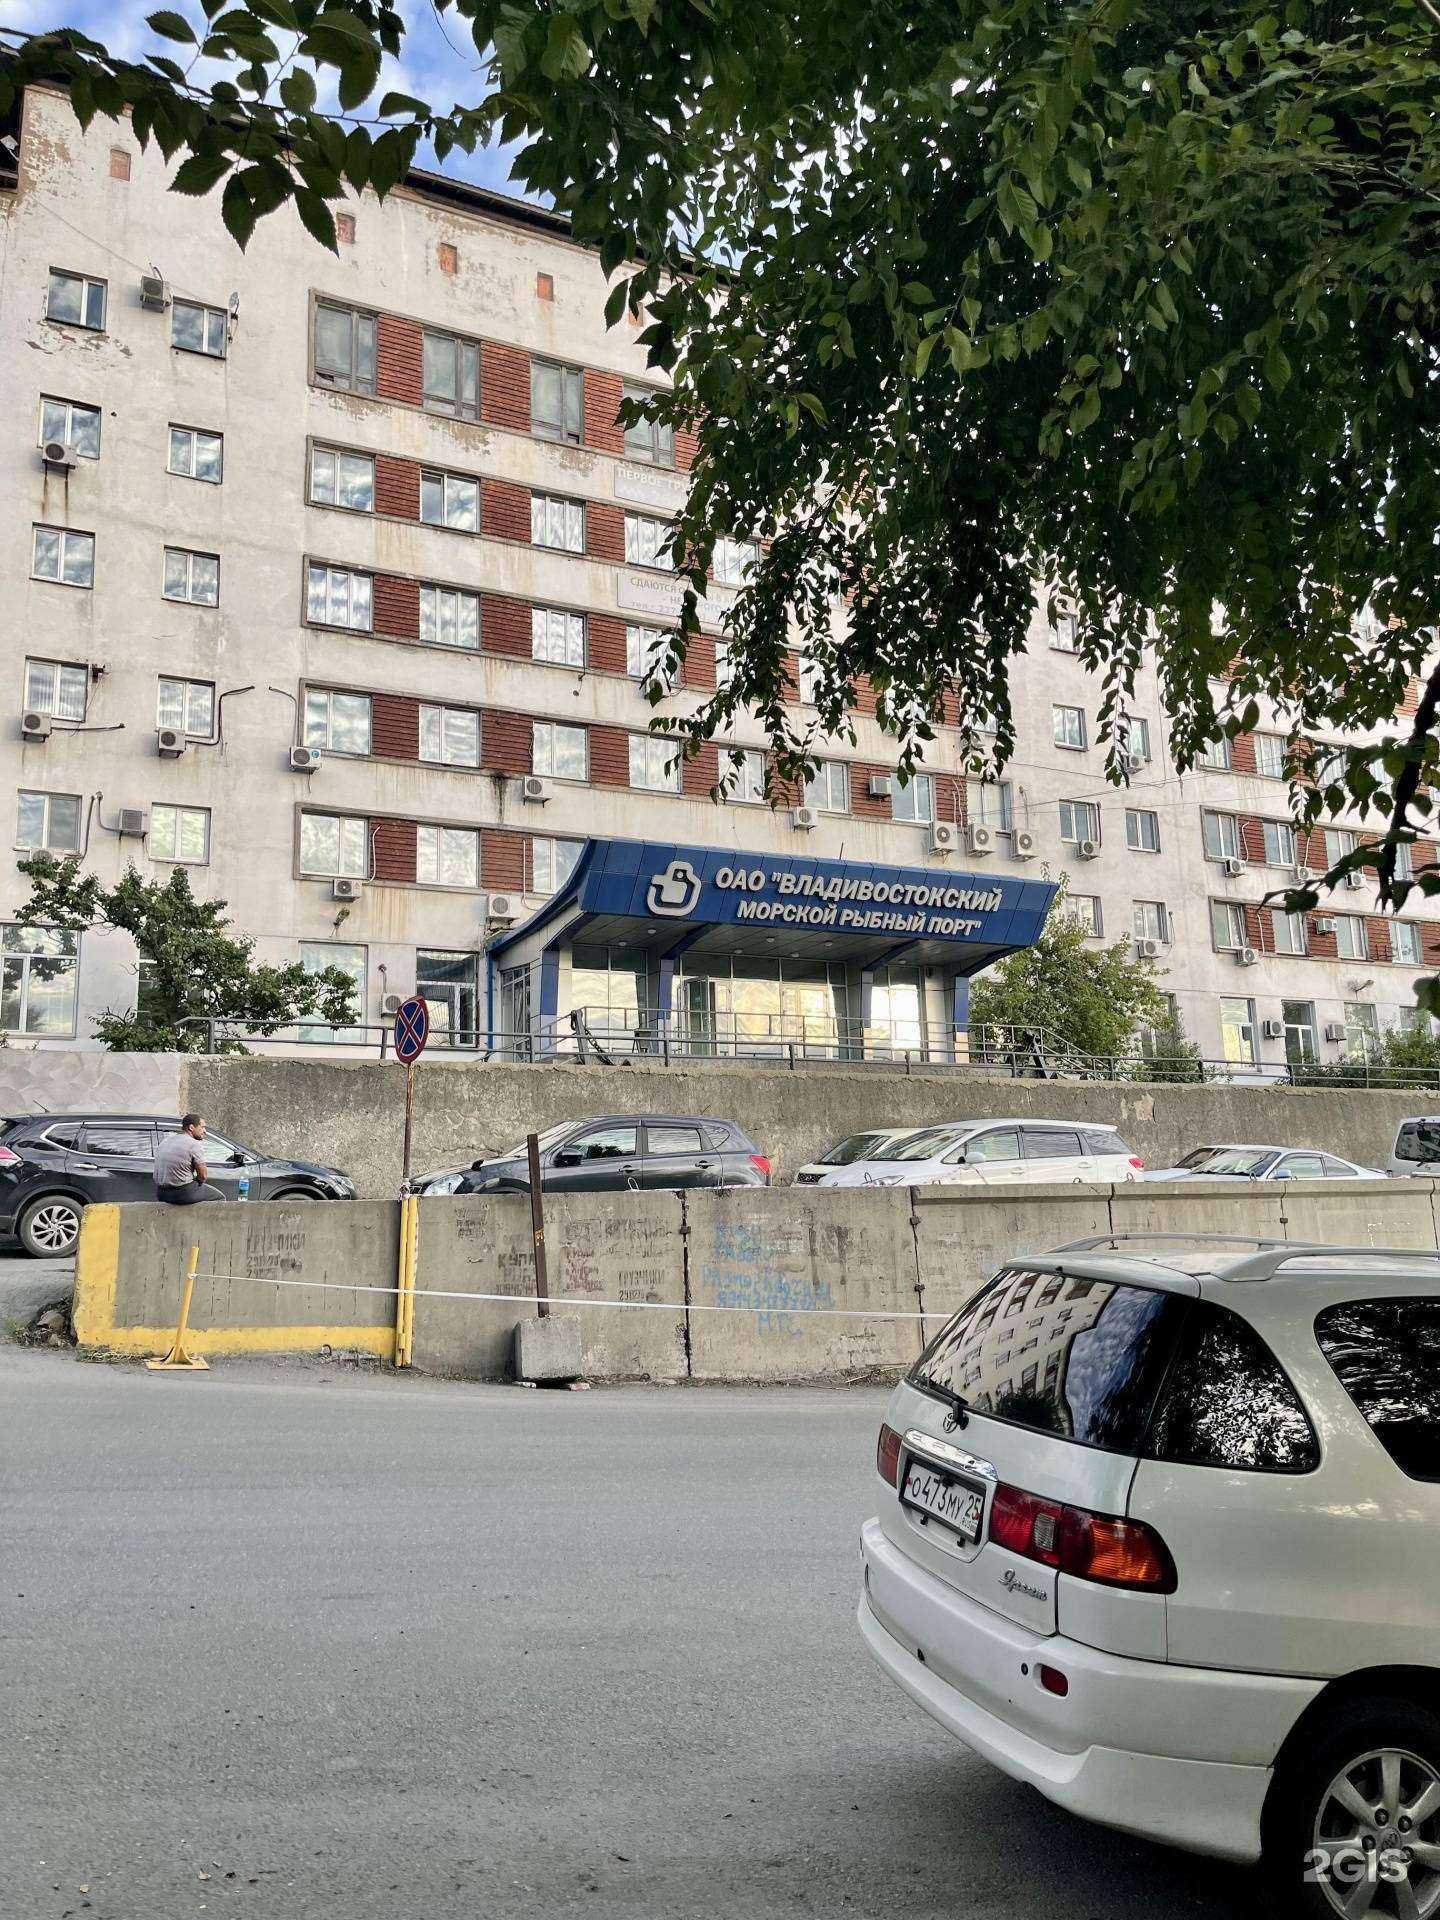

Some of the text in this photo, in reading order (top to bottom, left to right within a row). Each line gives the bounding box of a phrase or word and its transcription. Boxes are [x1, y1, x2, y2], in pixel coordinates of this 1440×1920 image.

[630, 577, 676, 592] СДАЮТСЯ
[715, 866, 1003, 912] ОАО "ВЛАДИВОСТОКСКИЙ
[737, 899, 982, 937] МОРСКОЙ РЫБНЫЙ ПОРТ"
